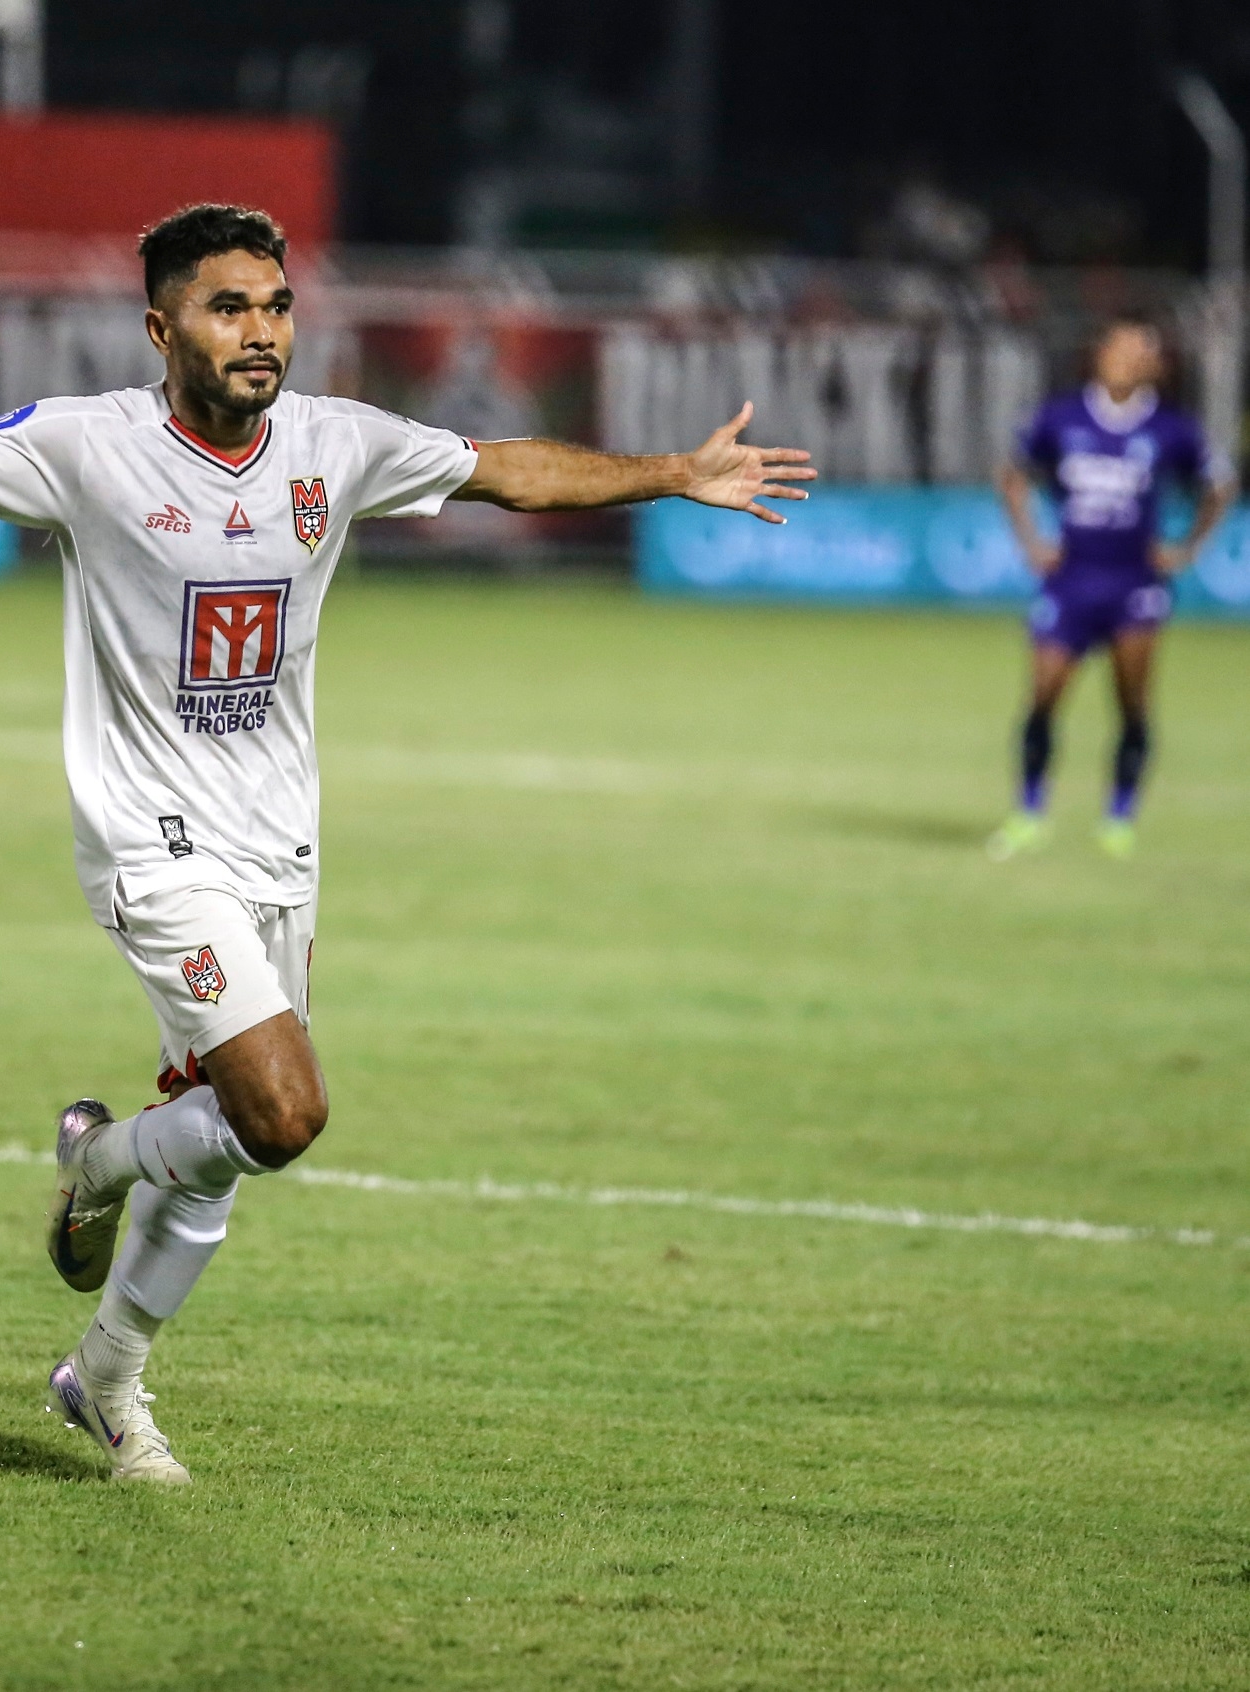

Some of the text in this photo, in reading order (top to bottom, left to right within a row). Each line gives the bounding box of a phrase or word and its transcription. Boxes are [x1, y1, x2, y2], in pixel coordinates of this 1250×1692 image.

[145, 516, 192, 534] SPECS
[175, 689, 275, 716] MINERAL
[179, 708, 267, 736] TROBOS
